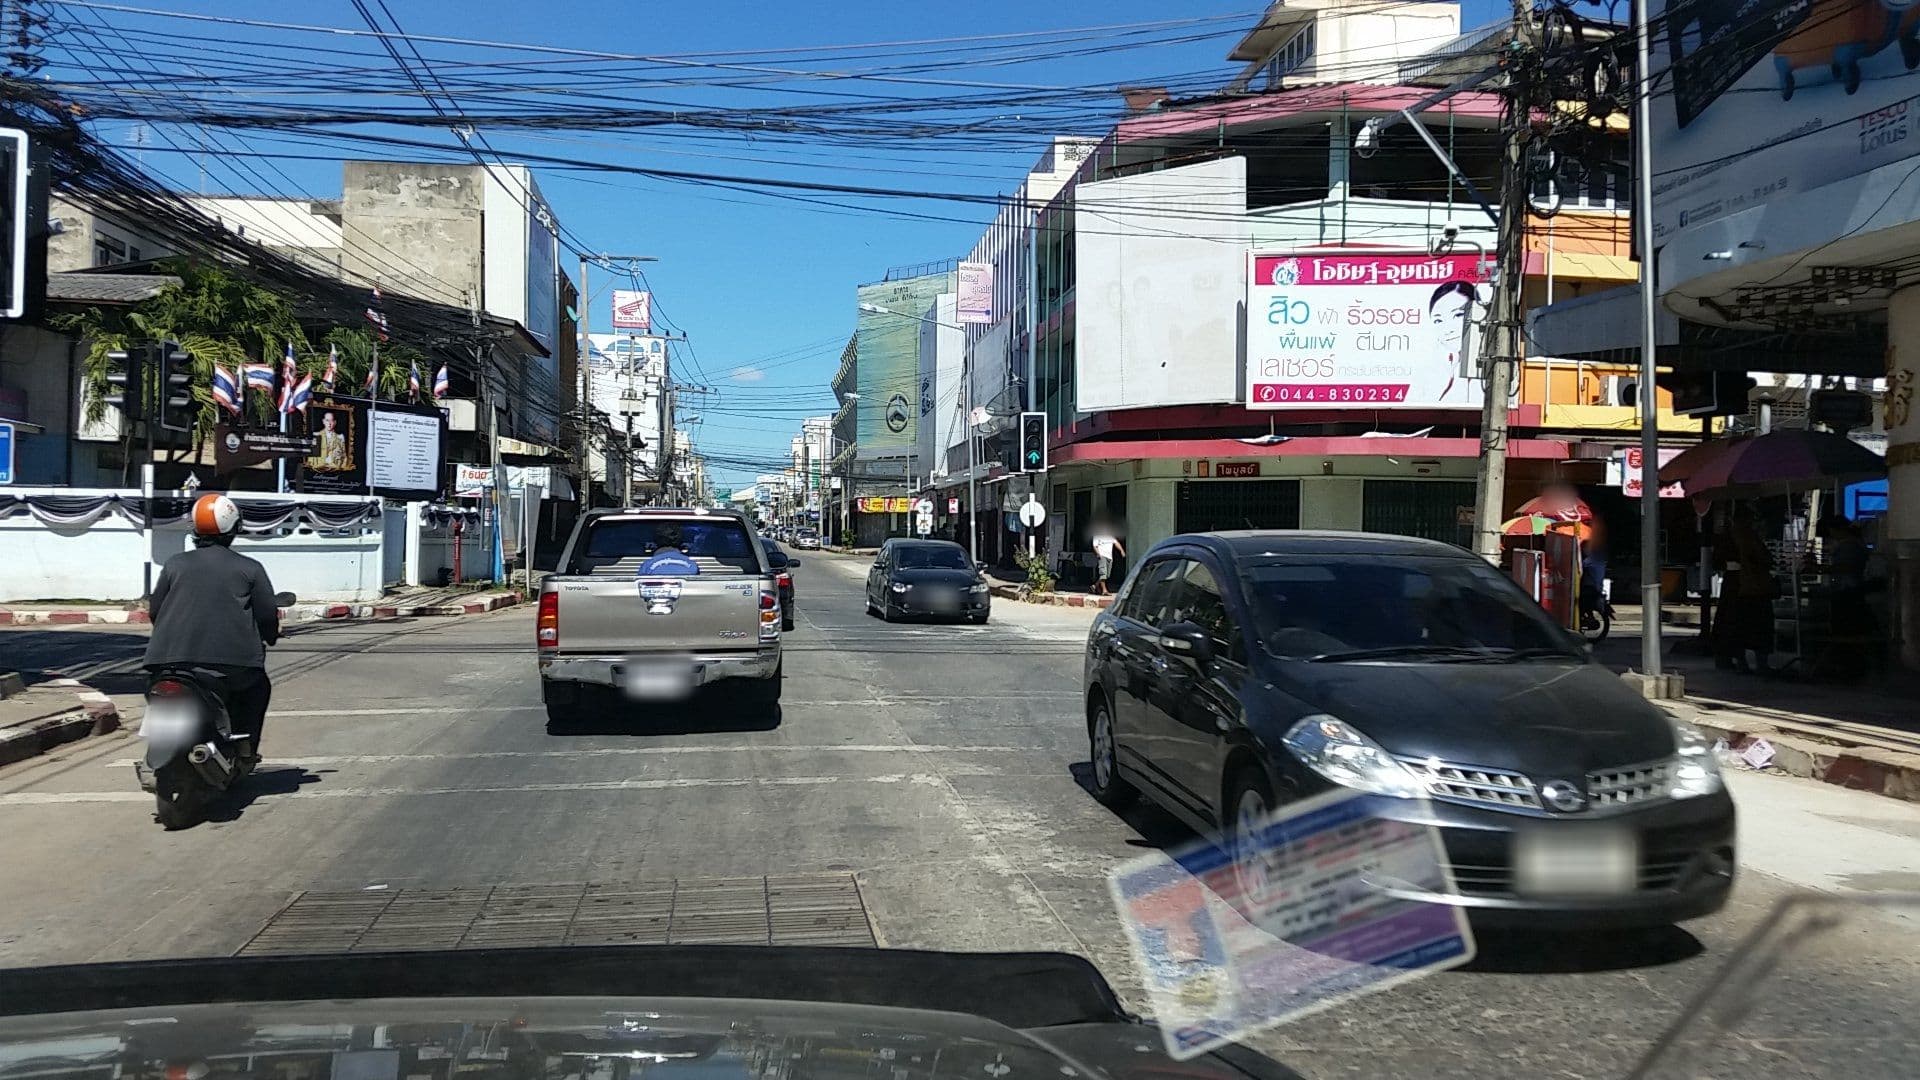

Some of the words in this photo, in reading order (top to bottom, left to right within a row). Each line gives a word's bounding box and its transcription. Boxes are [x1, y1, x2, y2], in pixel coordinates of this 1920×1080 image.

[1859, 125, 1908, 154] Lotus
[1268, 295, 1310, 325] สิว
[1348, 299, 1421, 325] ริ้วรอย
[1356, 331, 1410, 351] ตีนกา
[1260, 354, 1335, 378] เลเซอร์
[1280, 388, 1404, 401] 044-830234
